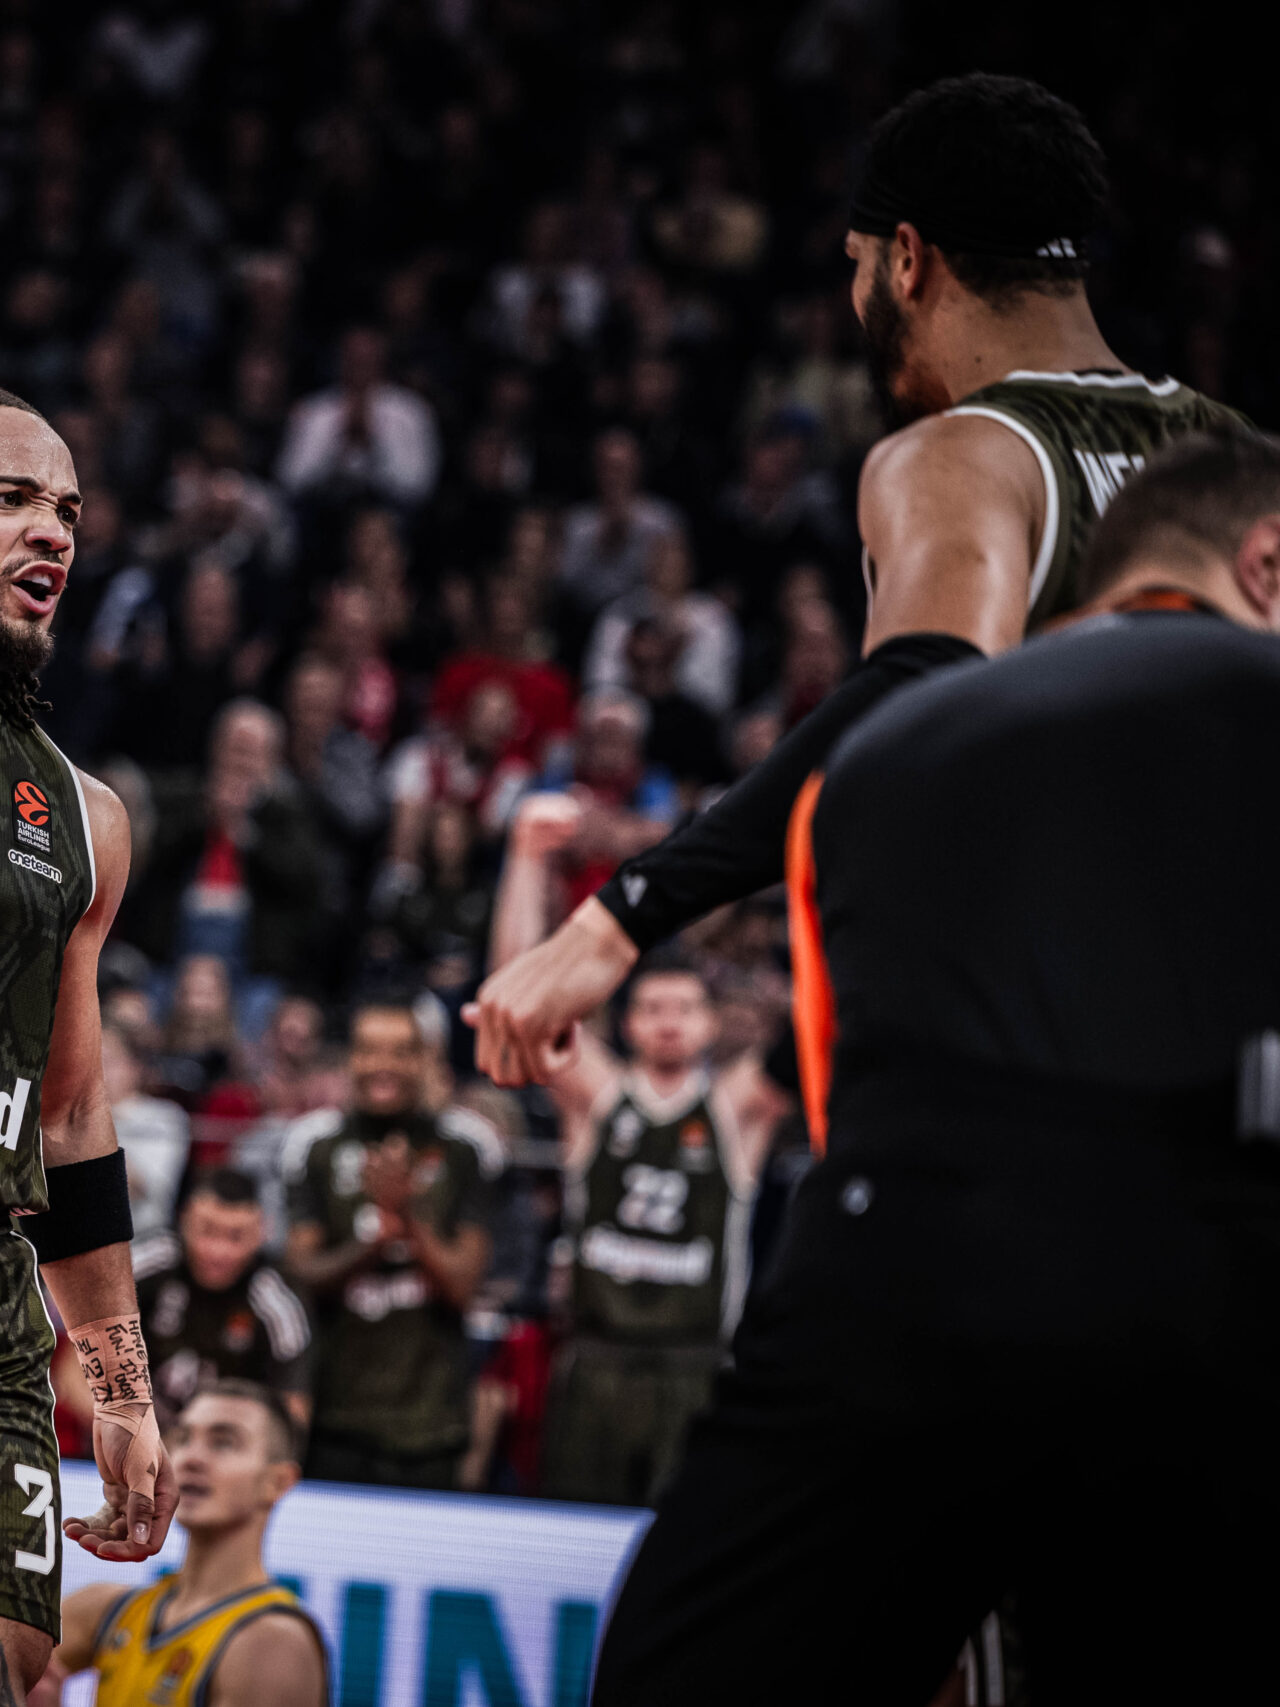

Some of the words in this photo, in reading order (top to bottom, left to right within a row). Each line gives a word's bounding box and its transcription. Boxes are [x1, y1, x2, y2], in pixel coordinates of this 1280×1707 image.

[17, 819, 50, 839] TURKISH
[17, 827, 50, 847] AIRLINES
[8, 849, 62, 884] oneteam
[14, 1463, 56, 1576] 3
